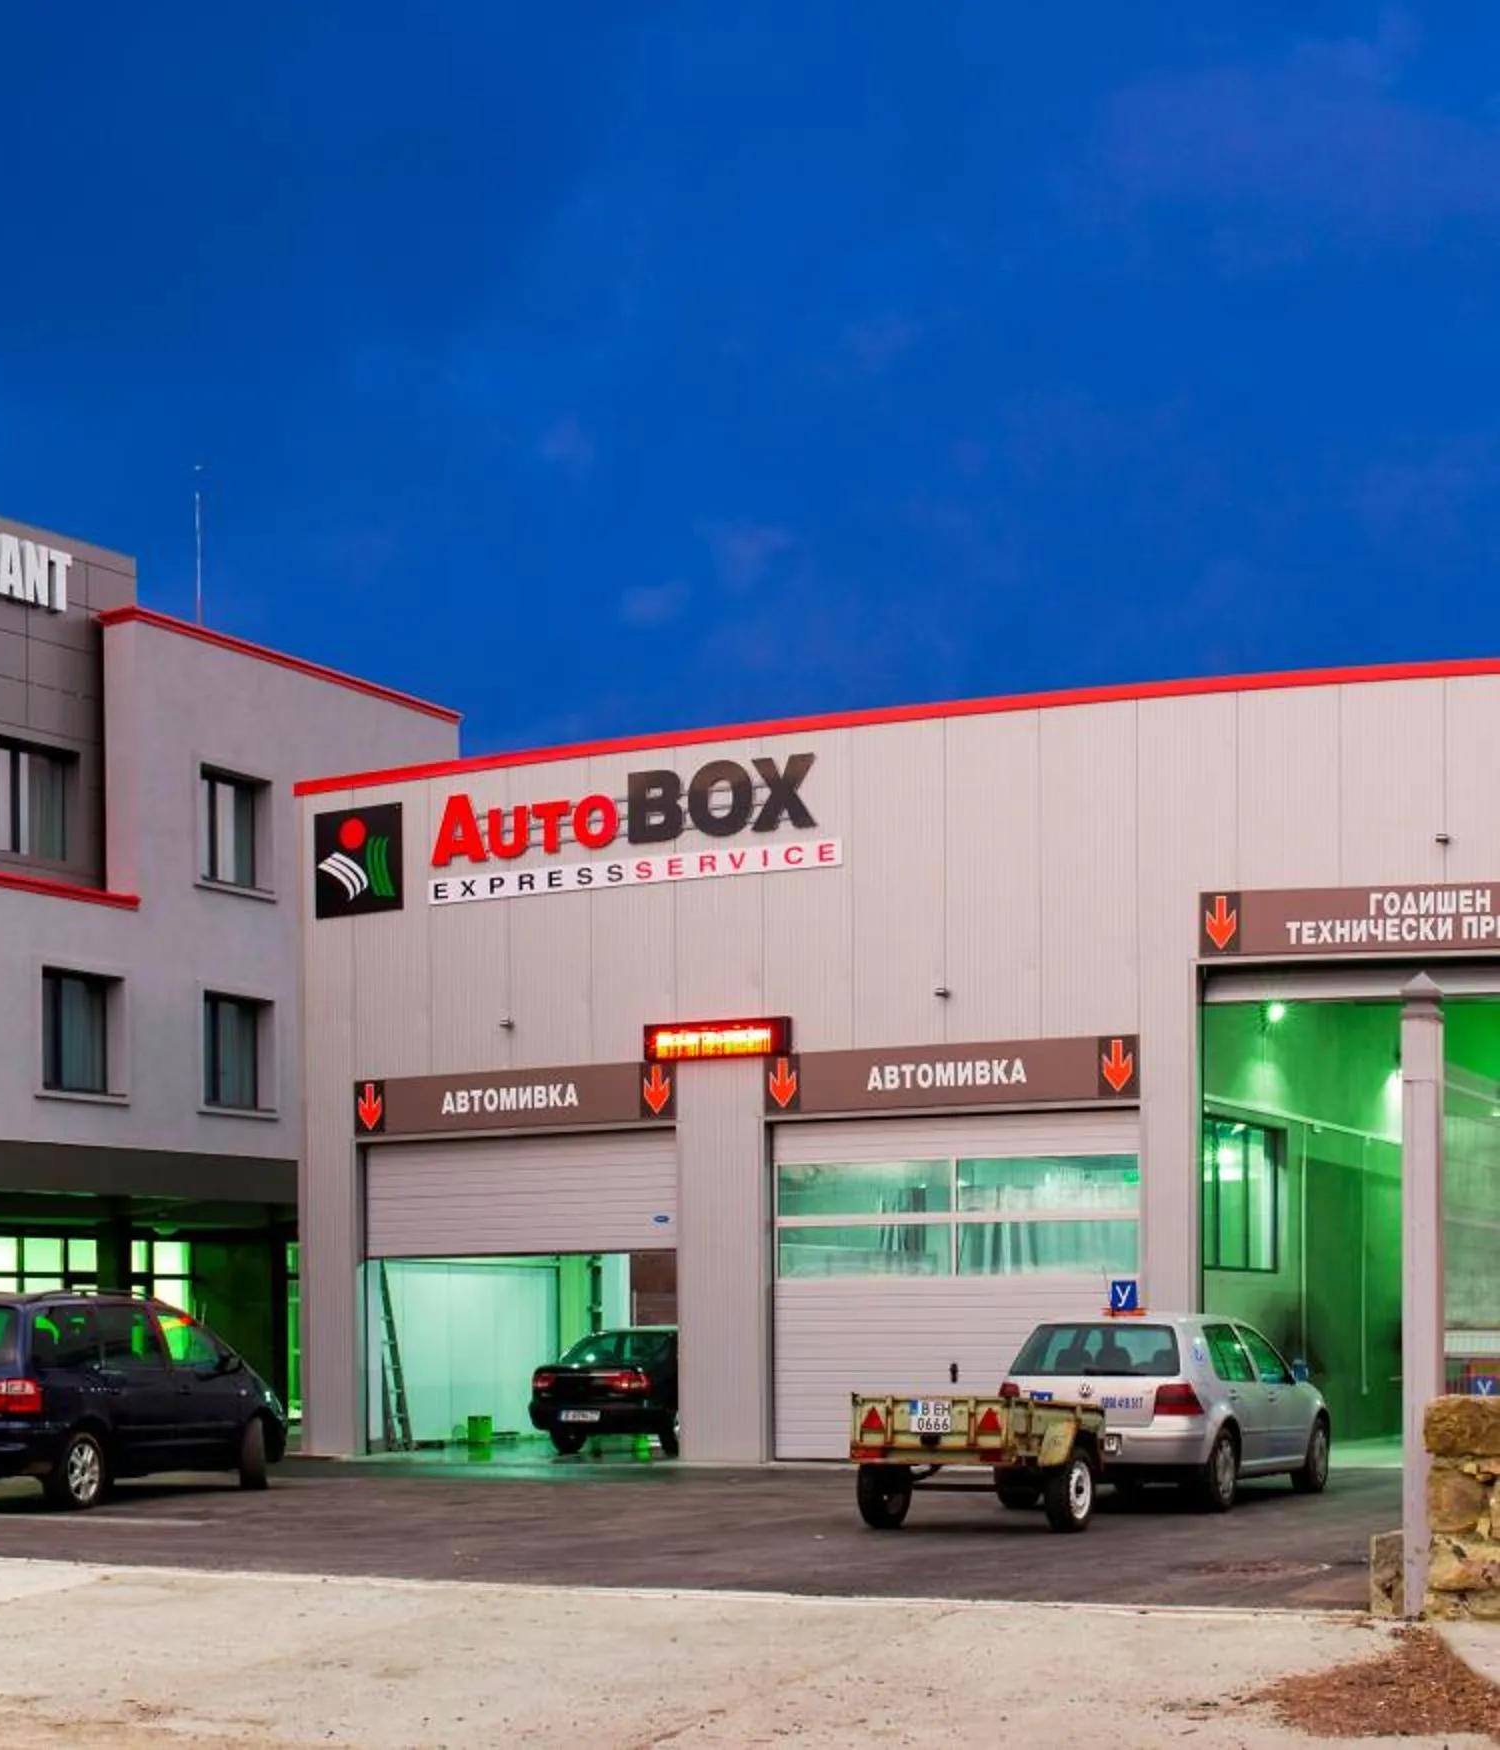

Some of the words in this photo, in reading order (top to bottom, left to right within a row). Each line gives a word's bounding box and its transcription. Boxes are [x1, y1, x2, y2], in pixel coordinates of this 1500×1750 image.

[1369, 889, 1491, 916] ГОДИШЕН
[1286, 917, 1453, 945] ТЕХНИЧЕСКИ
[867, 1058, 1027, 1092] АВТОМИВКА
[441, 1083, 579, 1115] АВТОМИВКА
[917, 1417, 949, 1431] 0666
